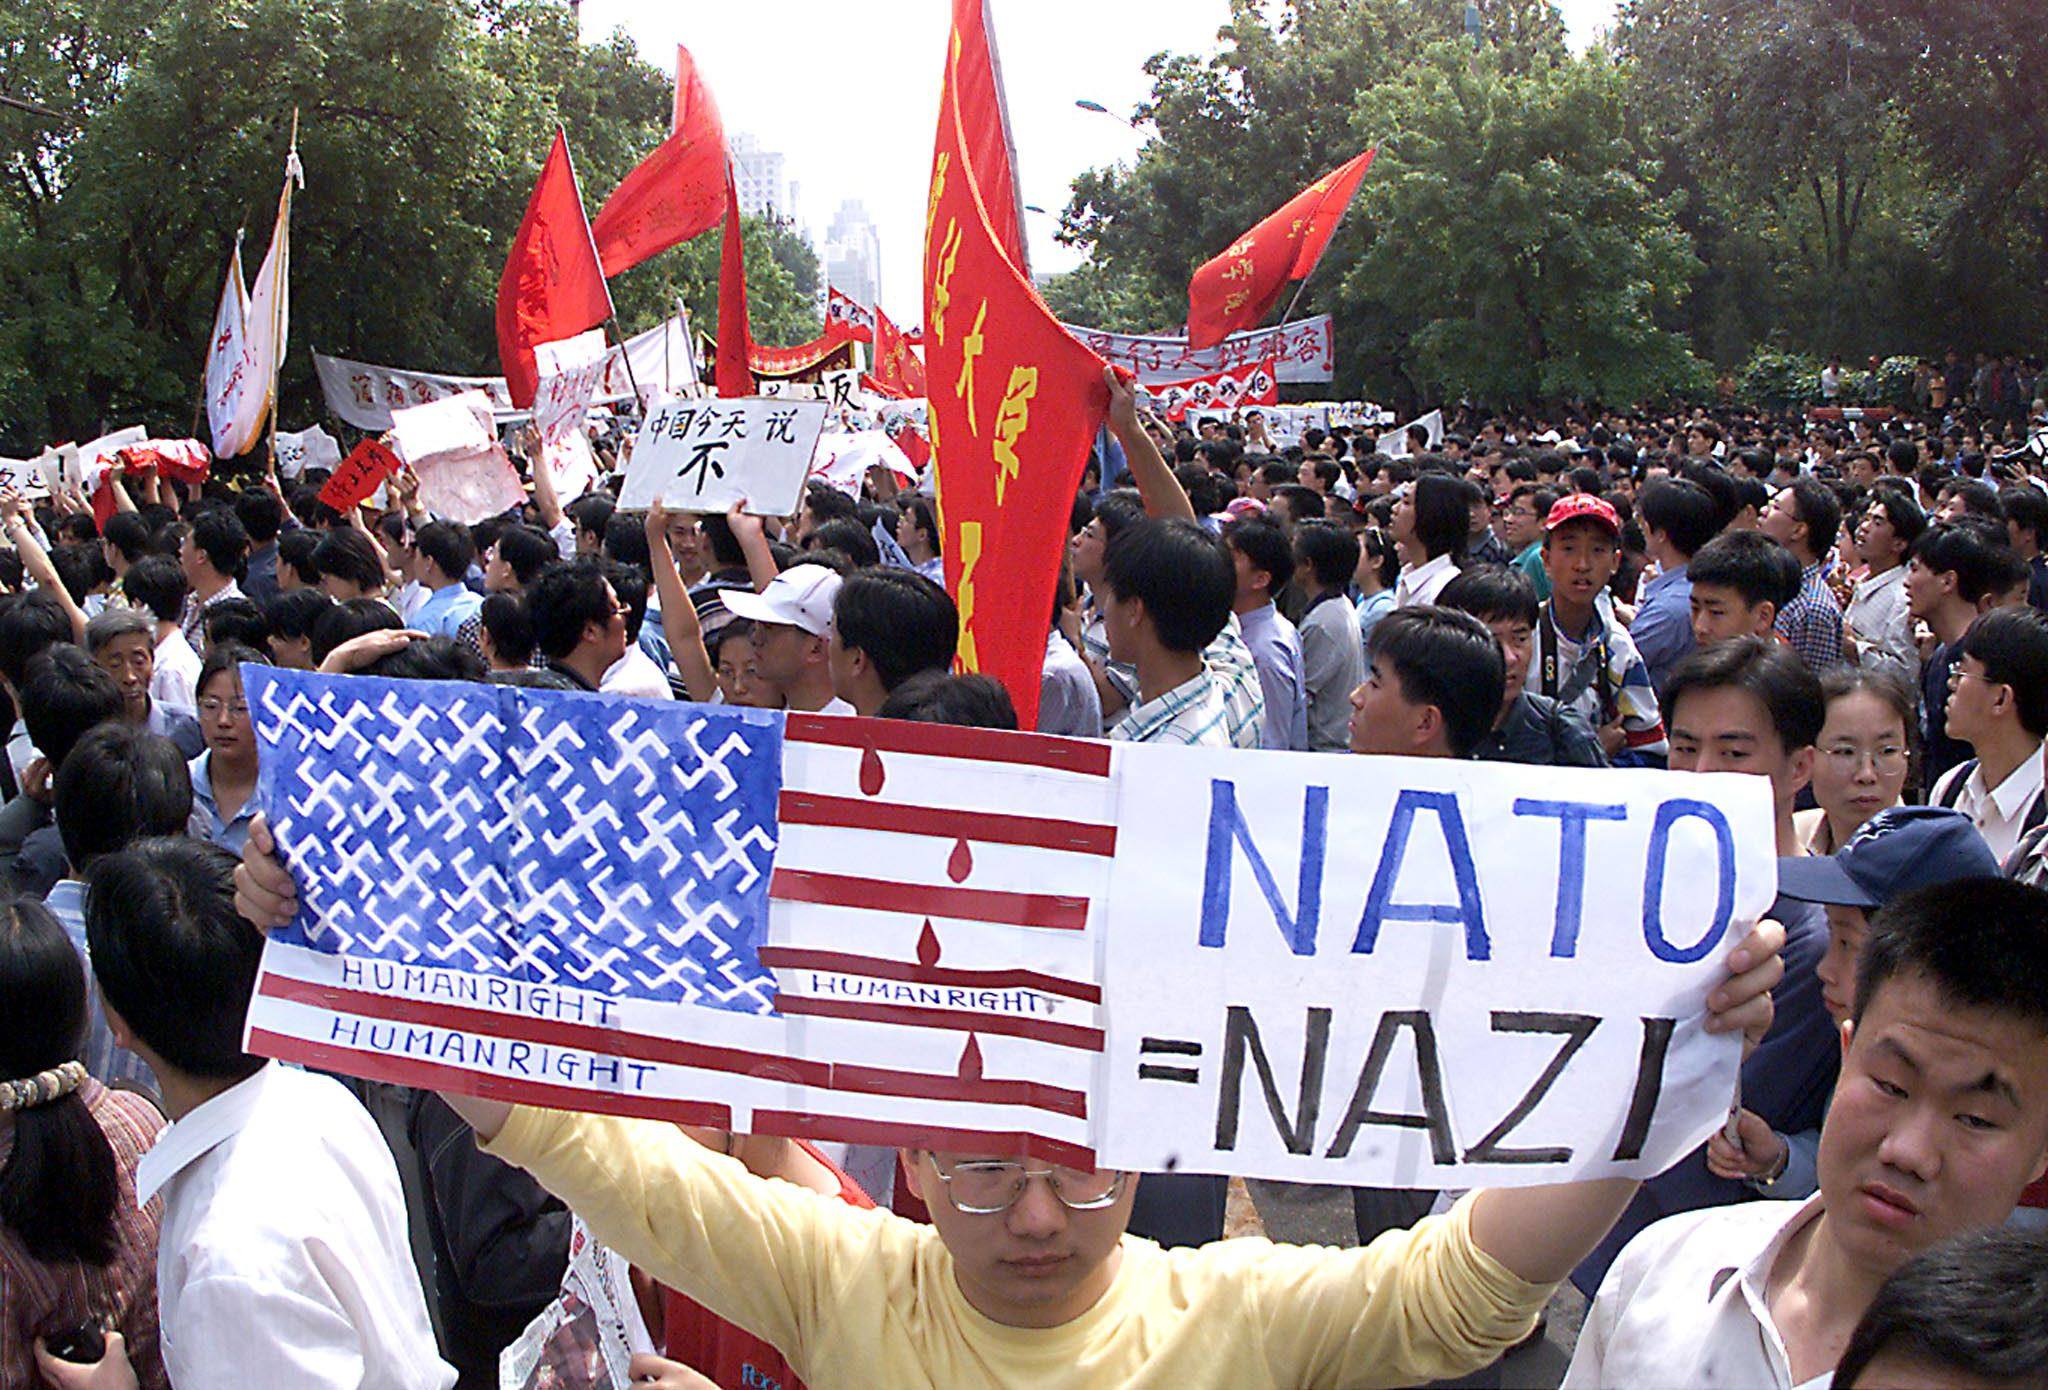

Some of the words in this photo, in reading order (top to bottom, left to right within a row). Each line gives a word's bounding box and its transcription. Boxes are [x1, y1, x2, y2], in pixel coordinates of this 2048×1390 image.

[829, 372, 861, 411] 反
[677, 441, 730, 496] 不
[1198, 778, 1737, 964] NATO
